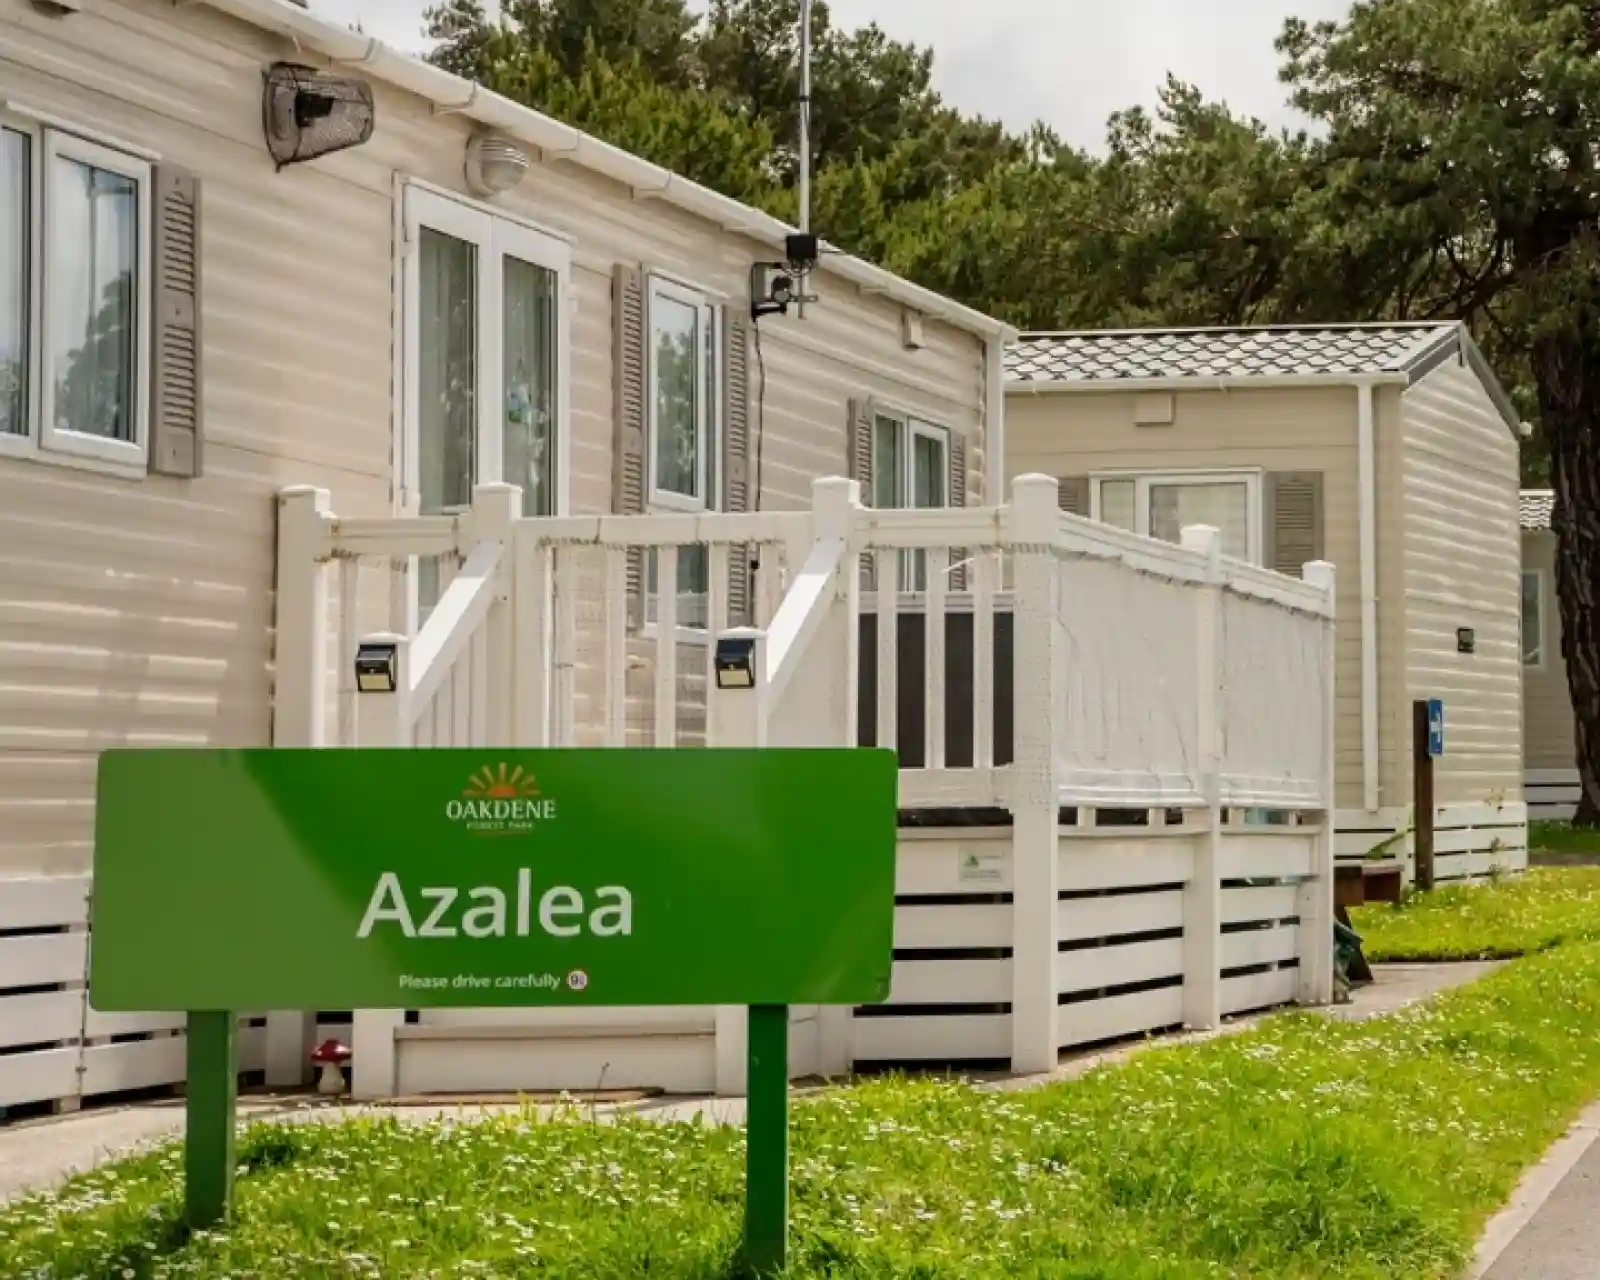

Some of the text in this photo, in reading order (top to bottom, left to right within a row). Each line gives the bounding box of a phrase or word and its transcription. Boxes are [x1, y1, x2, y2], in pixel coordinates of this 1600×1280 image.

[445, 799, 557, 821] OAKDENE
[355, 867, 633, 939] Azalea
[399, 974, 448, 989] Please
[452, 973, 491, 988] drive
[494, 973, 561, 991] carefully
